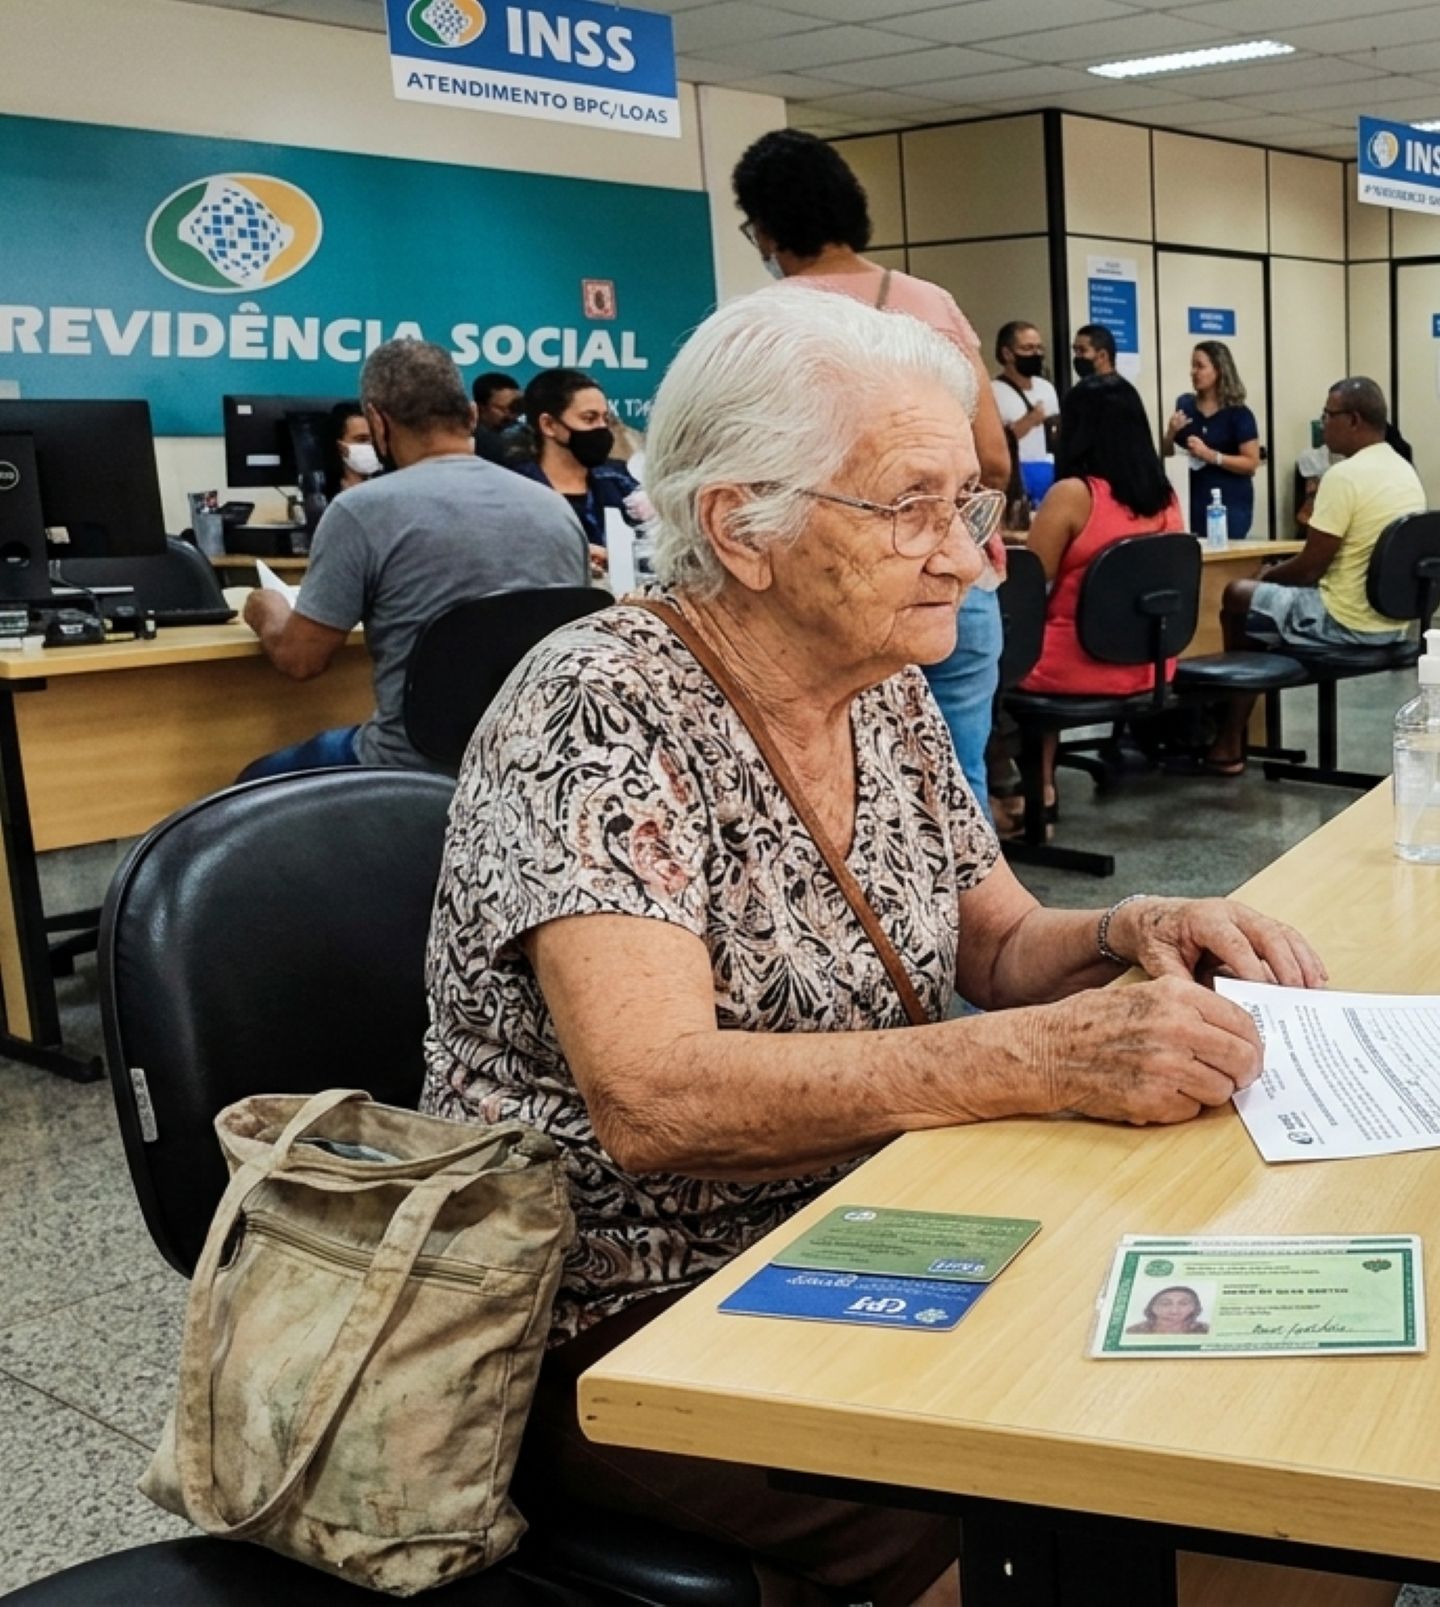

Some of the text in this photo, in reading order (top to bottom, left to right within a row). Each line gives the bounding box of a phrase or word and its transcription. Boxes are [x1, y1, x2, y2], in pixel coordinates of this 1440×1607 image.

[506, 7, 635, 73] INSS
[407, 72, 668, 124] ATENDIMENTO BPC/LOAS
[451, 323, 648, 369] SOCIAL
